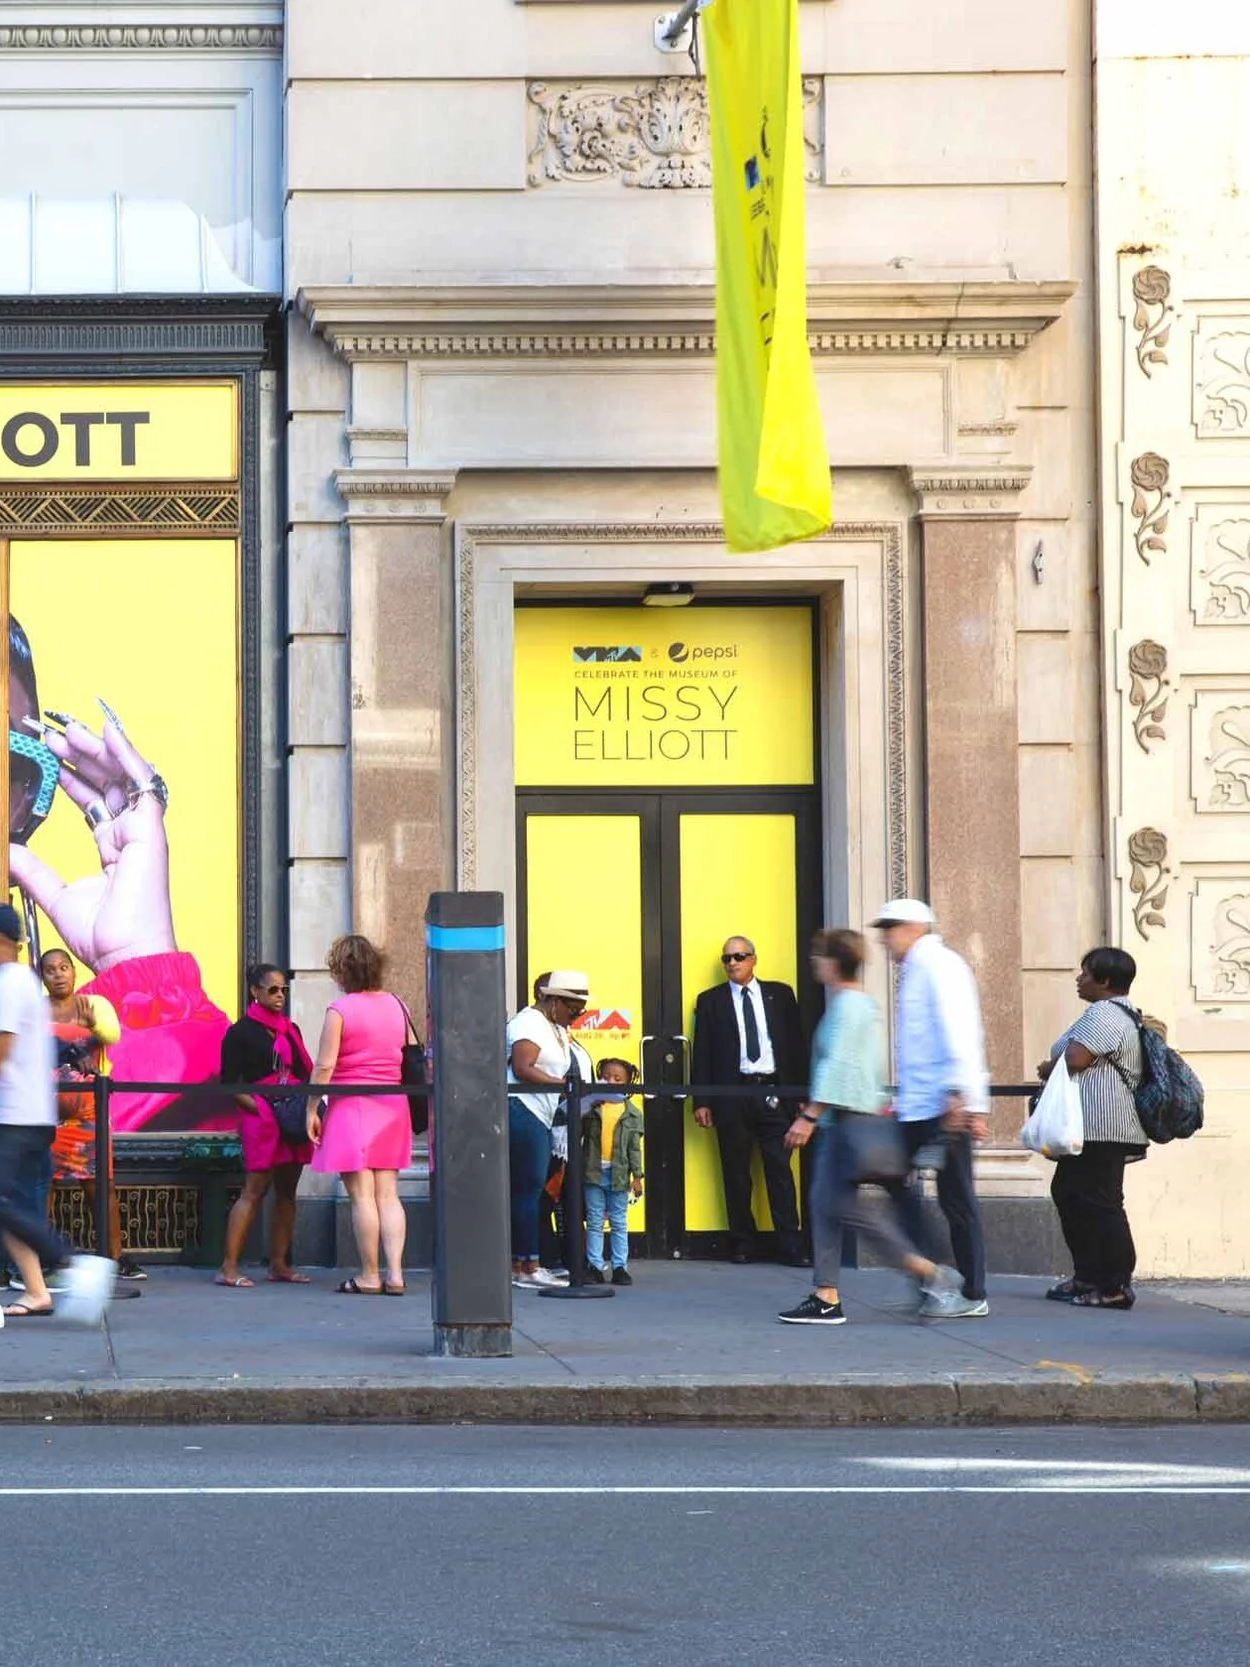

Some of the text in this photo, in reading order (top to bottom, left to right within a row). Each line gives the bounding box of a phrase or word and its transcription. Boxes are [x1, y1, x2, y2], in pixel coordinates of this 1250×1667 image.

[692, 644, 737, 661] pepsi
[574, 670, 738, 679] CELEBRATE THE MUSEUM OF
[574, 685, 738, 721] MISSY
[574, 729, 738, 760] ELLIOTT
